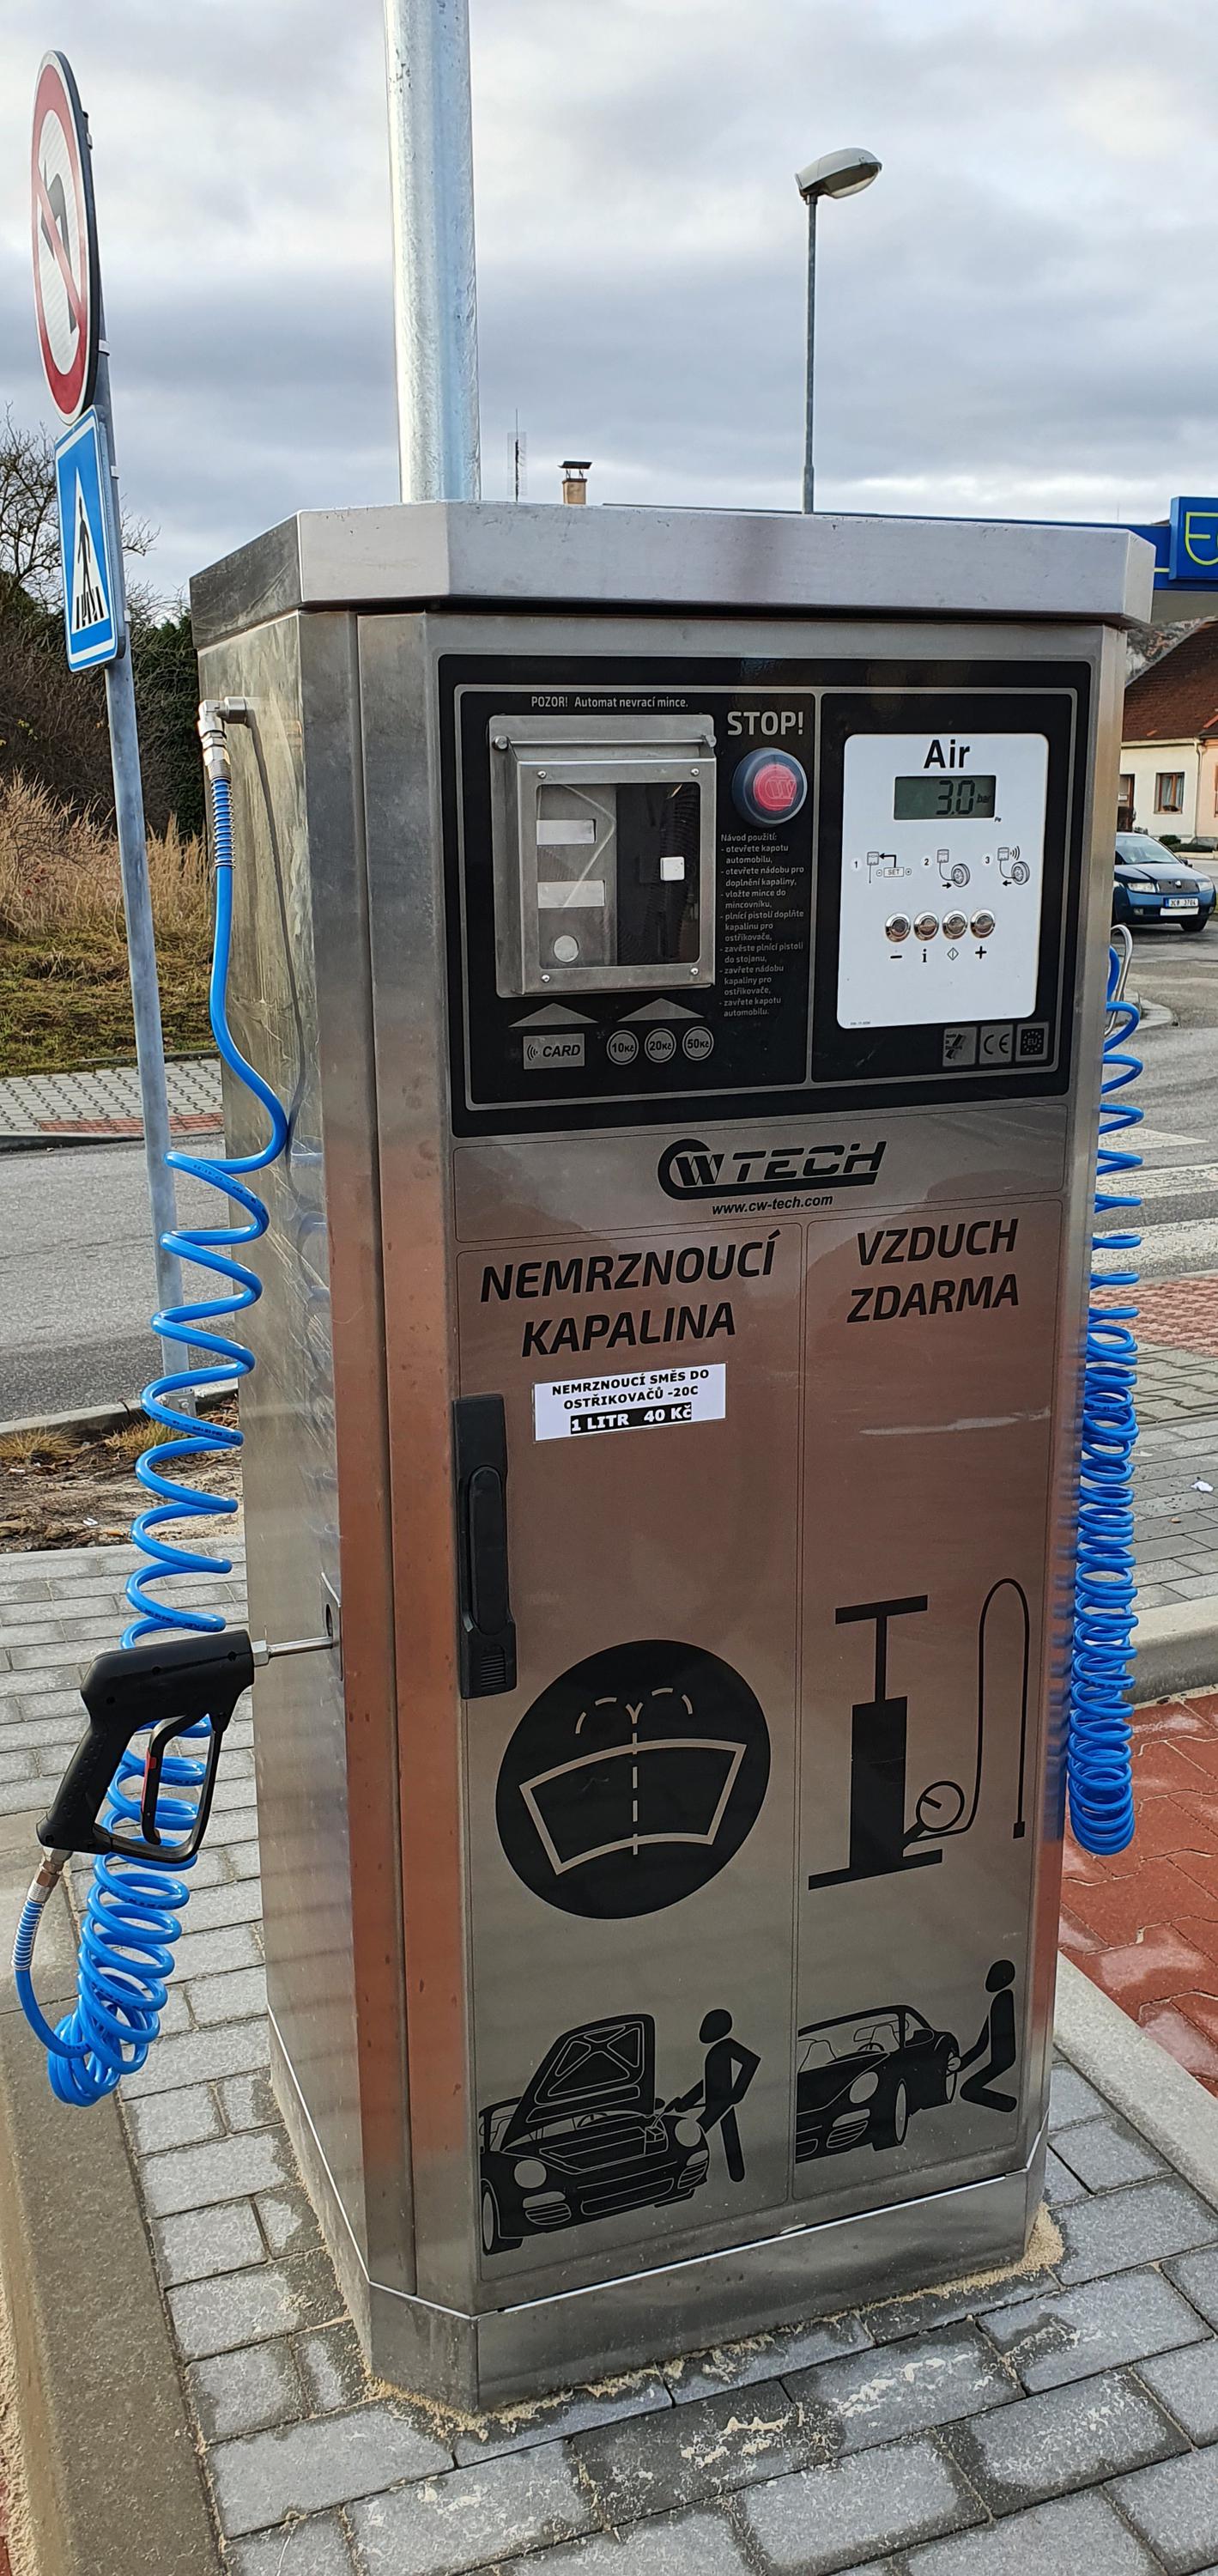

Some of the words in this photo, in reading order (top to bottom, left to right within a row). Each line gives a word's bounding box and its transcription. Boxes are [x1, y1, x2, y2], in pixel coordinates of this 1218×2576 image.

[531, 696, 568, 708] POZOR!
[574, 697, 617, 708] Automat
[619, 696, 656, 708] nevrací
[657, 696, 688, 708] mince.
[727, 711, 803, 736] STOP!
[924, 739, 970, 769] Air
[977, 793, 991, 804] bar
[748, 832, 778, 842] použití:
[725, 844, 760, 853] otevřete
[761, 844, 789, 853] kapotu
[725, 855, 773, 864] automobilu,
[725, 866, 759, 875] otevřete
[725, 878, 760, 888] doplnění
[761, 878, 797, 887] kapaliny,
[725, 890, 750, 898] vložte
[725, 923, 759, 932] kapalinu
[724, 977, 757, 986] kapaliny
[754, 997, 782, 1005] kapotu
[542, 1044, 580, 1058] CARD
[712, 1195, 833, 1216] www.cw-tech.com
[857, 1218, 1019, 1267] VZDUCH
[480, 1230, 781, 1303] NEMRZNOUCÍ
[846, 1273, 1020, 1324] ZDARMA
[521, 1302, 736, 1358] KAPALINA
[552, 1373, 645, 1395] NEMRZNOUCÍ
[649, 1370, 686, 1385] SMĚS
[690, 1369, 709, 1381] DO
[564, 1386, 664, 1410] OSTŘIKOVAČŮ
[668, 1385, 699, 1400] -20C
[571, 1419, 581, 1432] 1
[586, 1413, 629, 1431] LITR
[644, 1408, 665, 1423] 40
[670, 1405, 692, 1420] Kč
